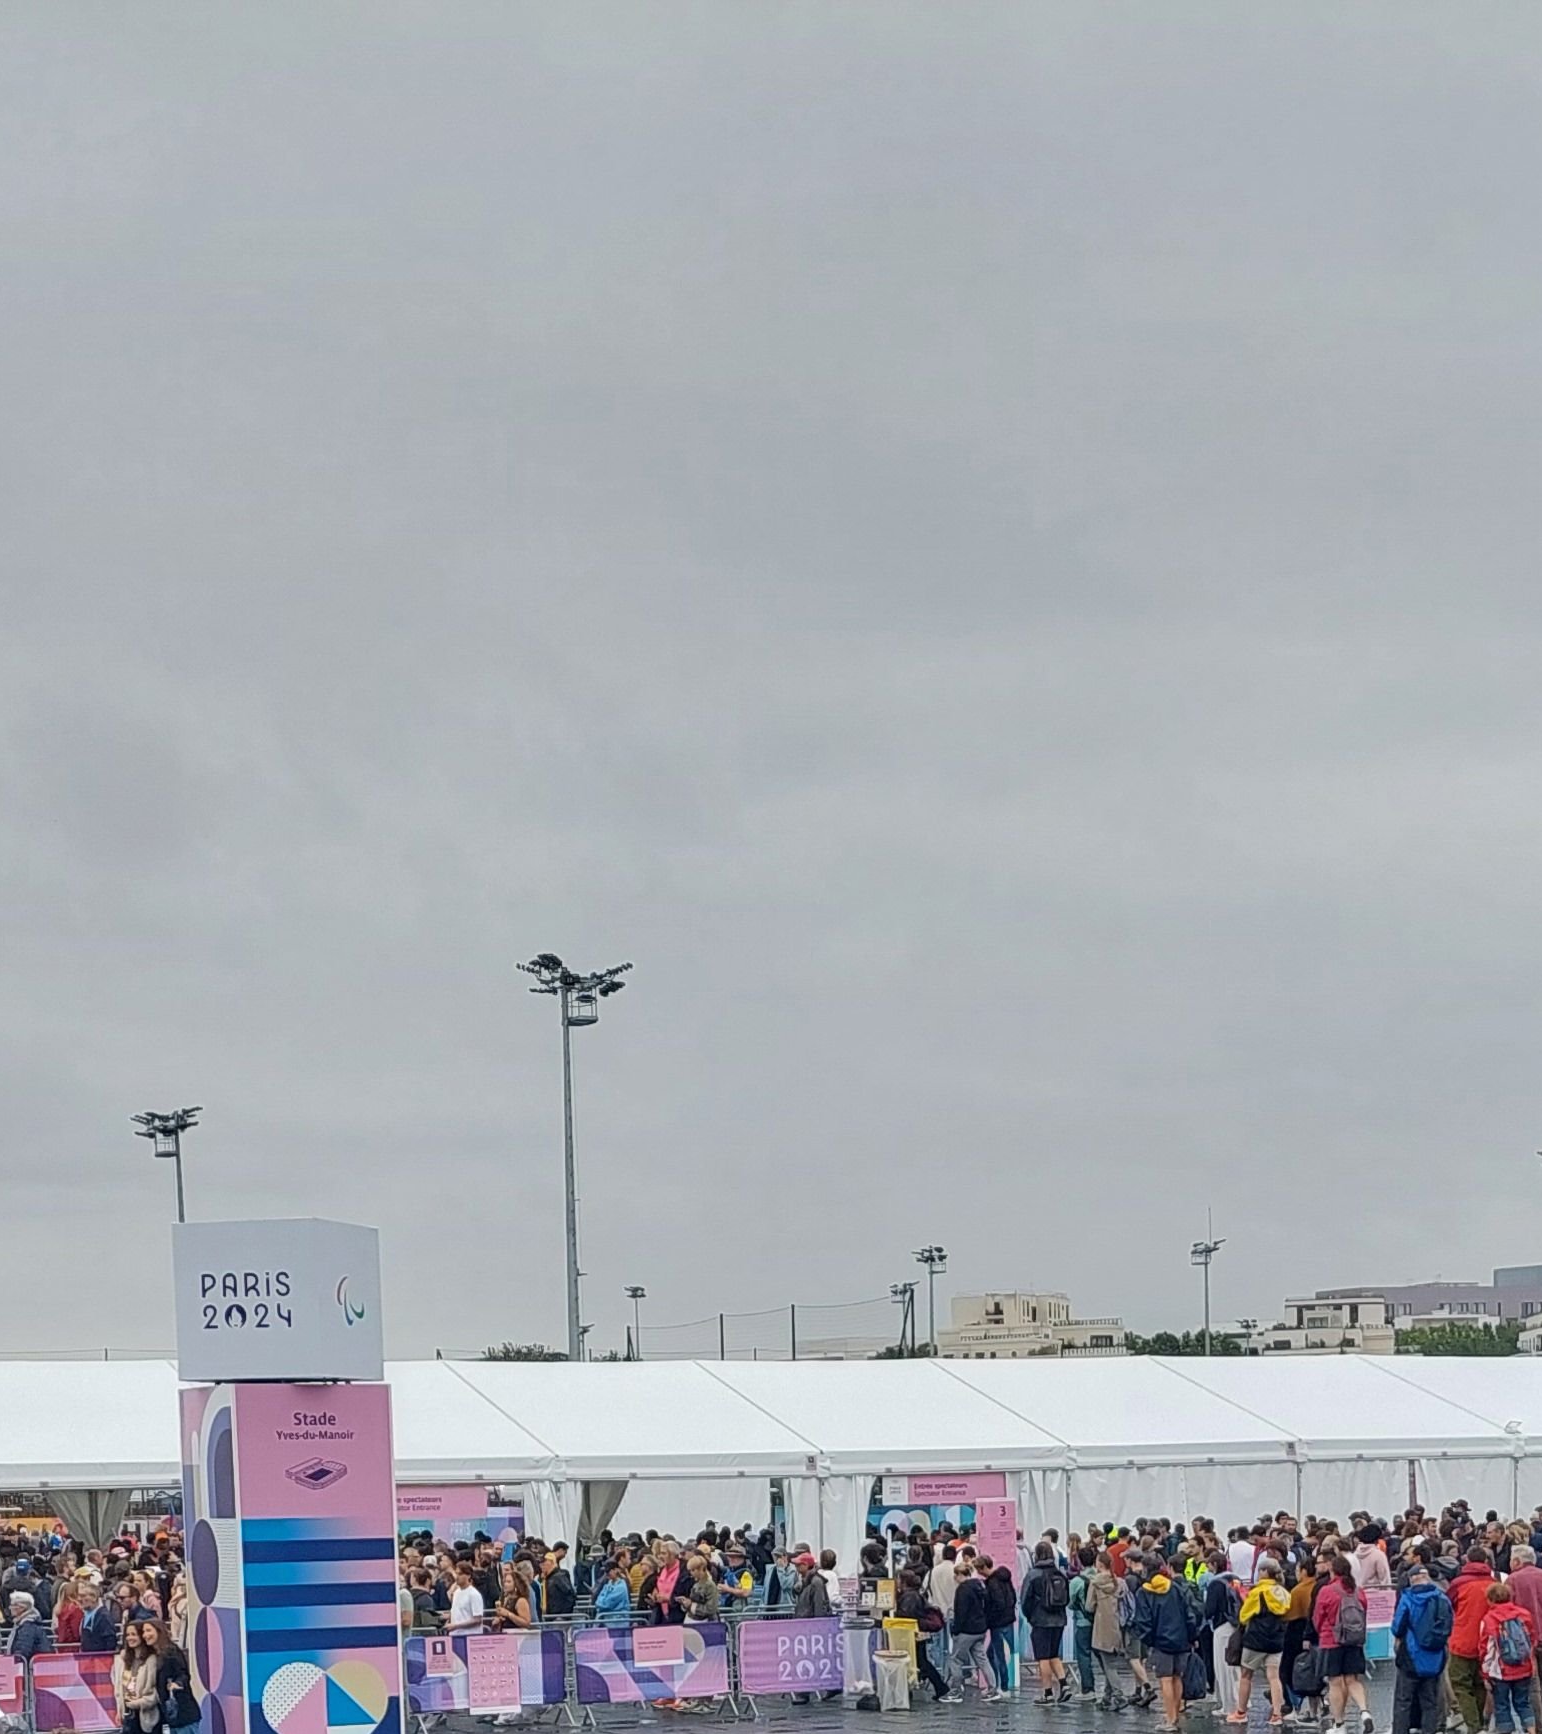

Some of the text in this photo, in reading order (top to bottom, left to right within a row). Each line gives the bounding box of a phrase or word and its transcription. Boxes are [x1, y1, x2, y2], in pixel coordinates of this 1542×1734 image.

[203, 1302, 292, 1329] 2024
[293, 1412, 337, 1426] Stade
[276, 1430, 355, 1440] Yves-du-Manoir
[999, 1505, 1007, 1517] 3
